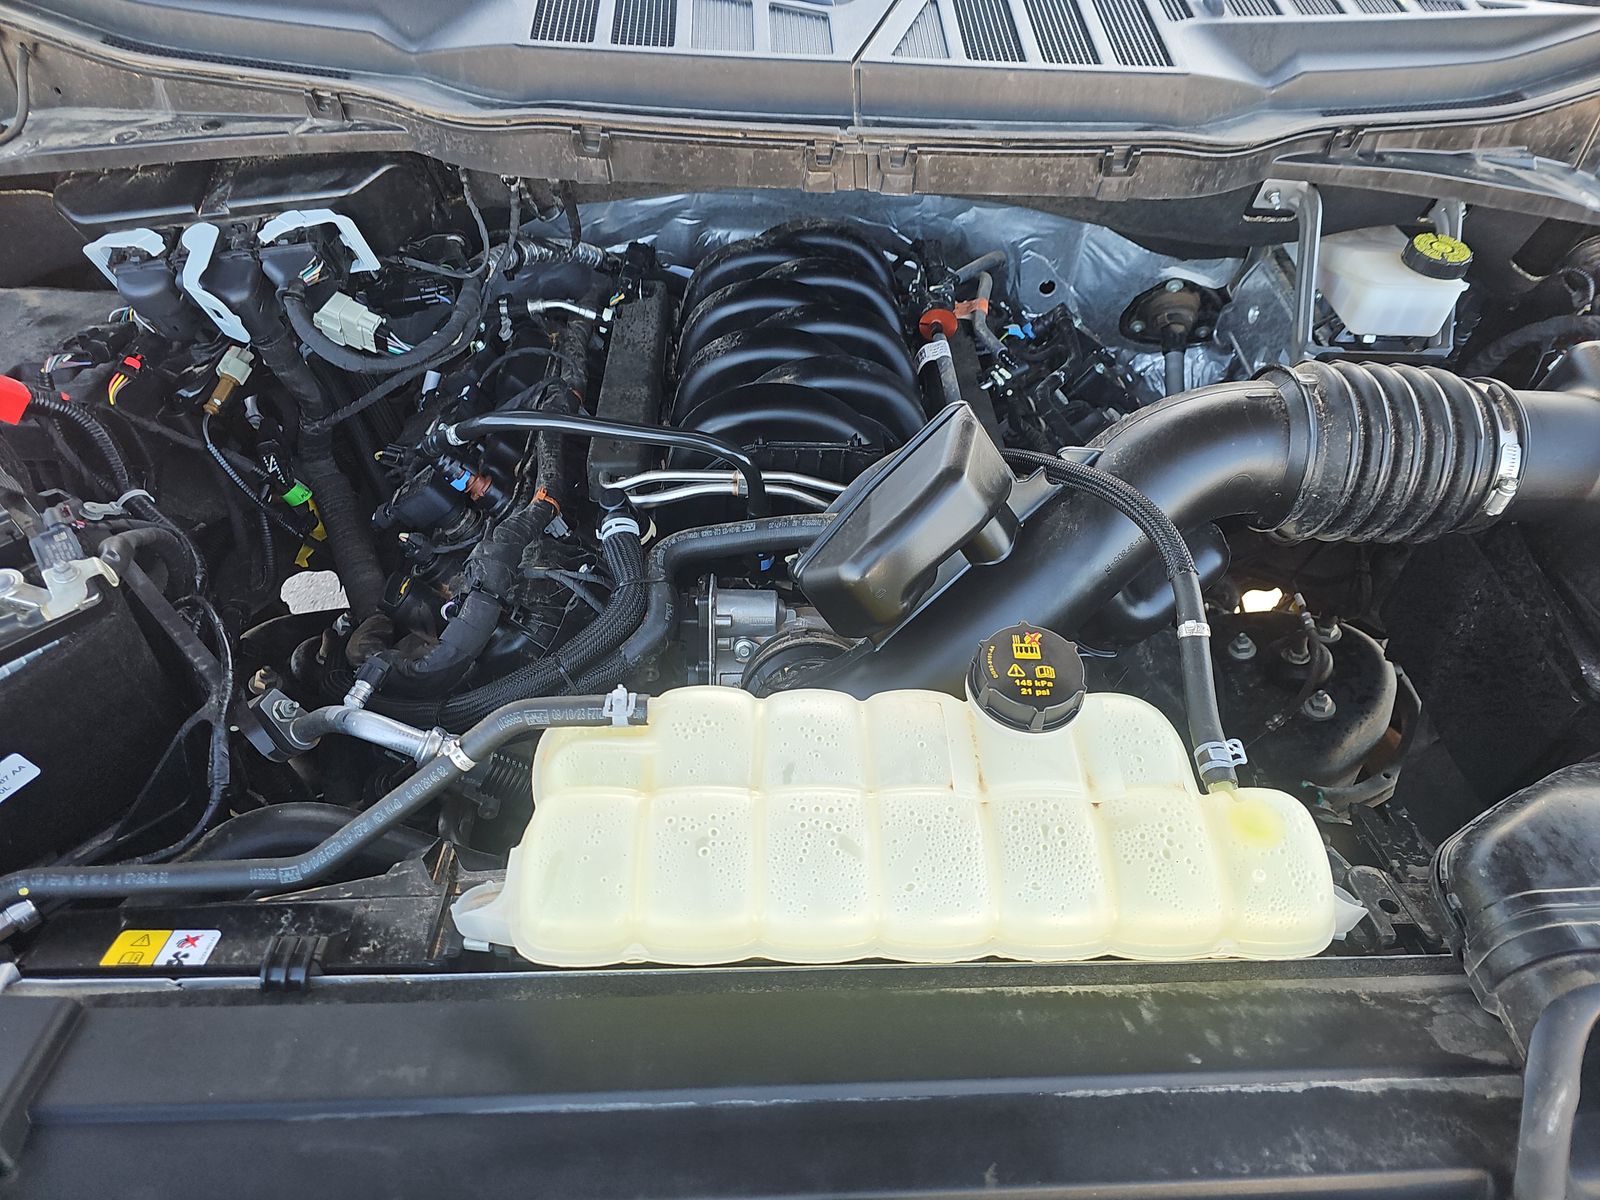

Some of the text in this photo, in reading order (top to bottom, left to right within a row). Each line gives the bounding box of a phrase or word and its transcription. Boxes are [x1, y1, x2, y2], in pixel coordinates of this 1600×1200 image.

[1014, 679, 1054, 687] 145 kPa
[1035, 688, 1051, 697] psi
